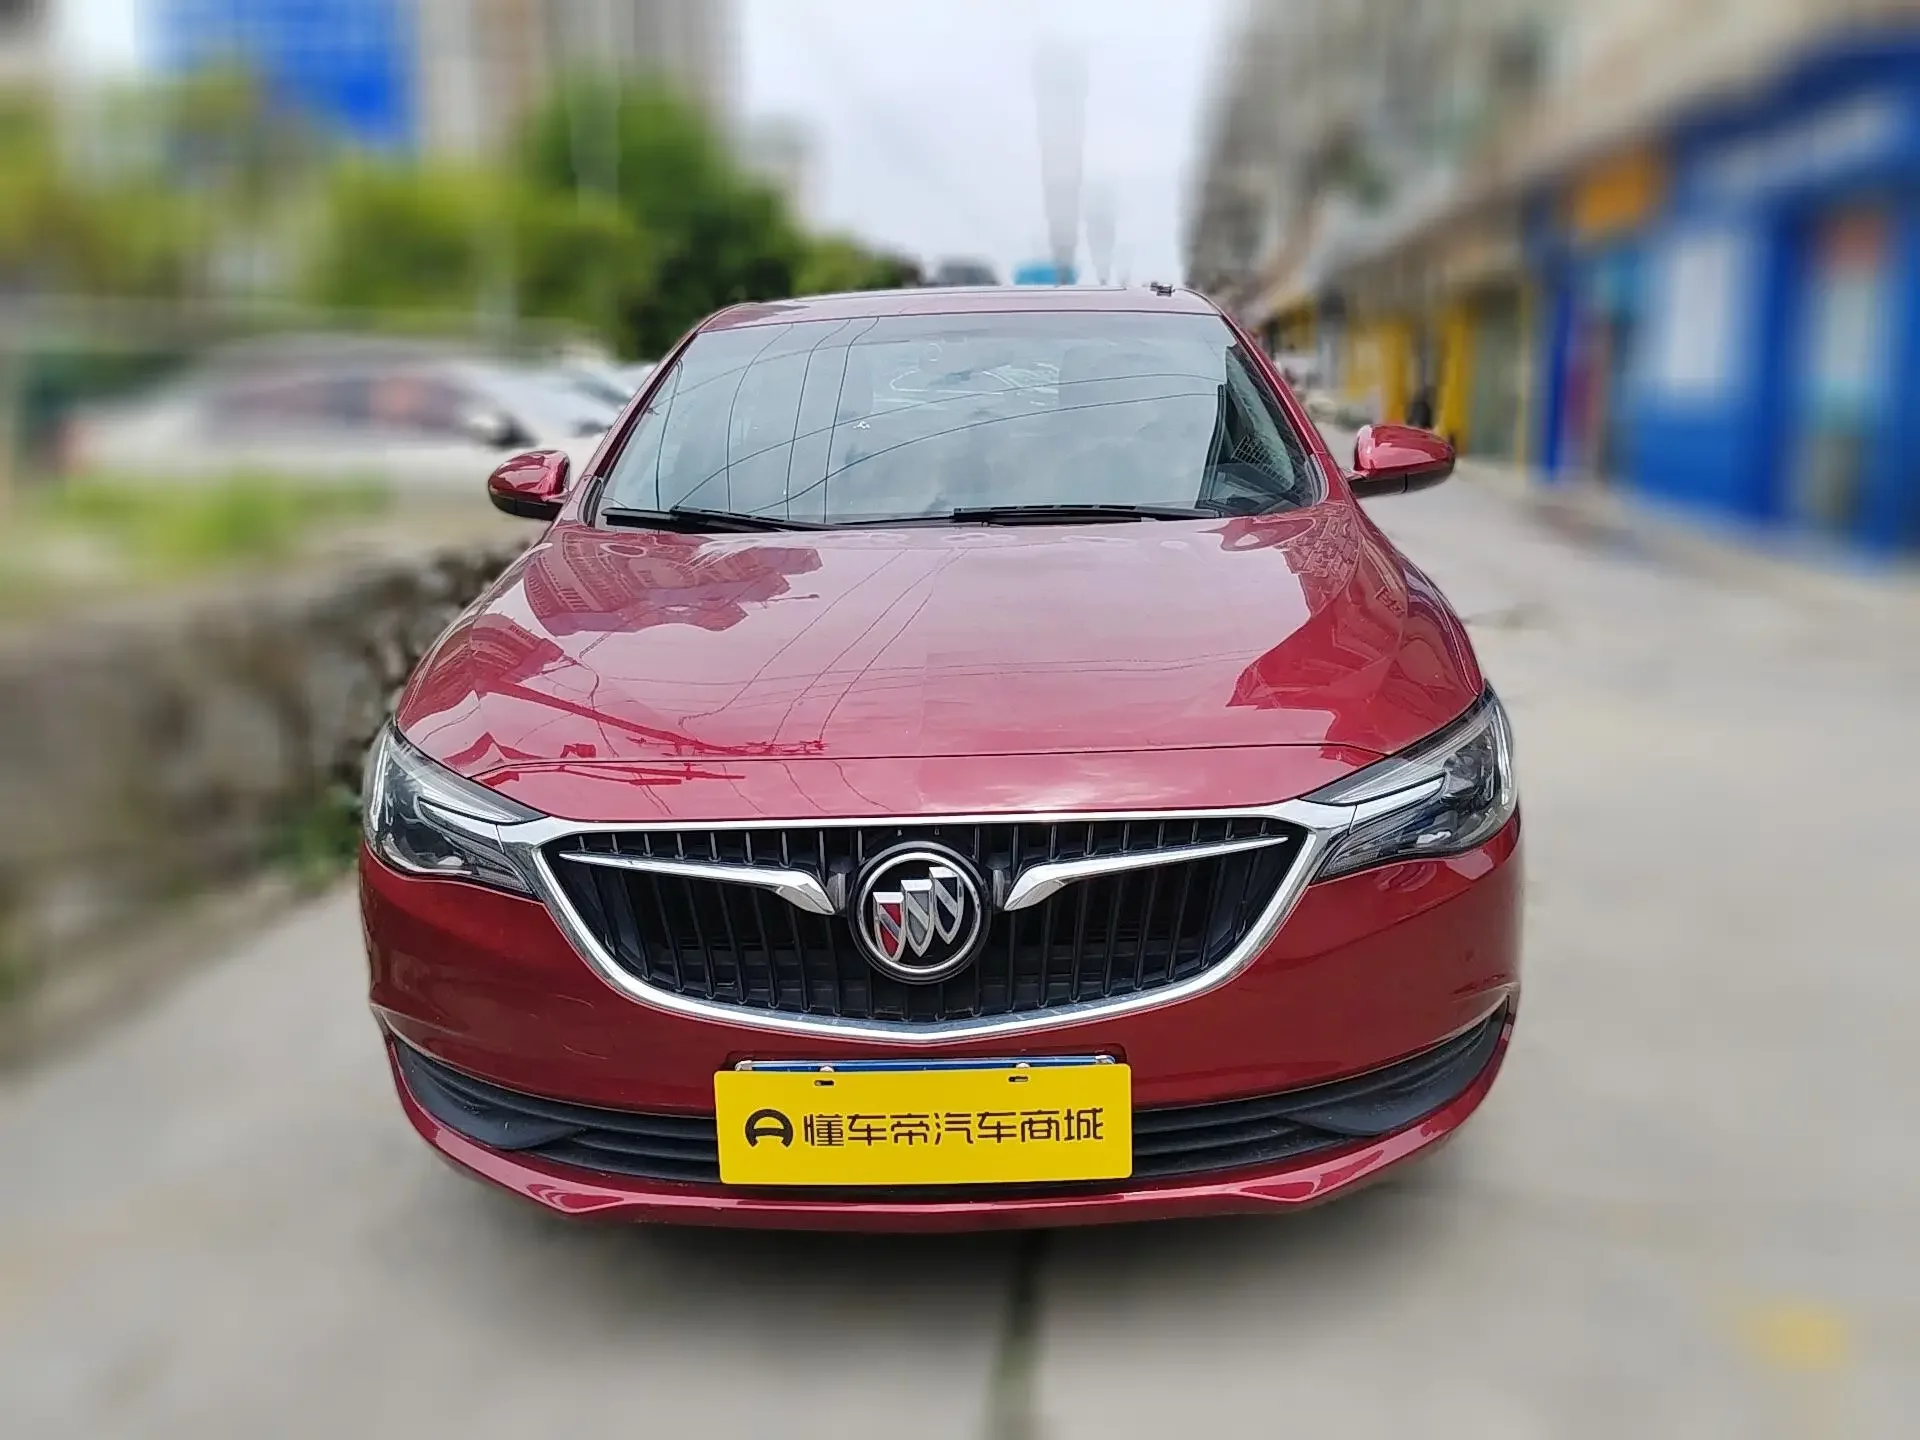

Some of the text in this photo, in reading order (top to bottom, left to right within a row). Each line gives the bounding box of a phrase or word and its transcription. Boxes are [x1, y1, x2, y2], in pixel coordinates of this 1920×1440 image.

[803, 1107, 1104, 1147] 懂车帝汽车商城
